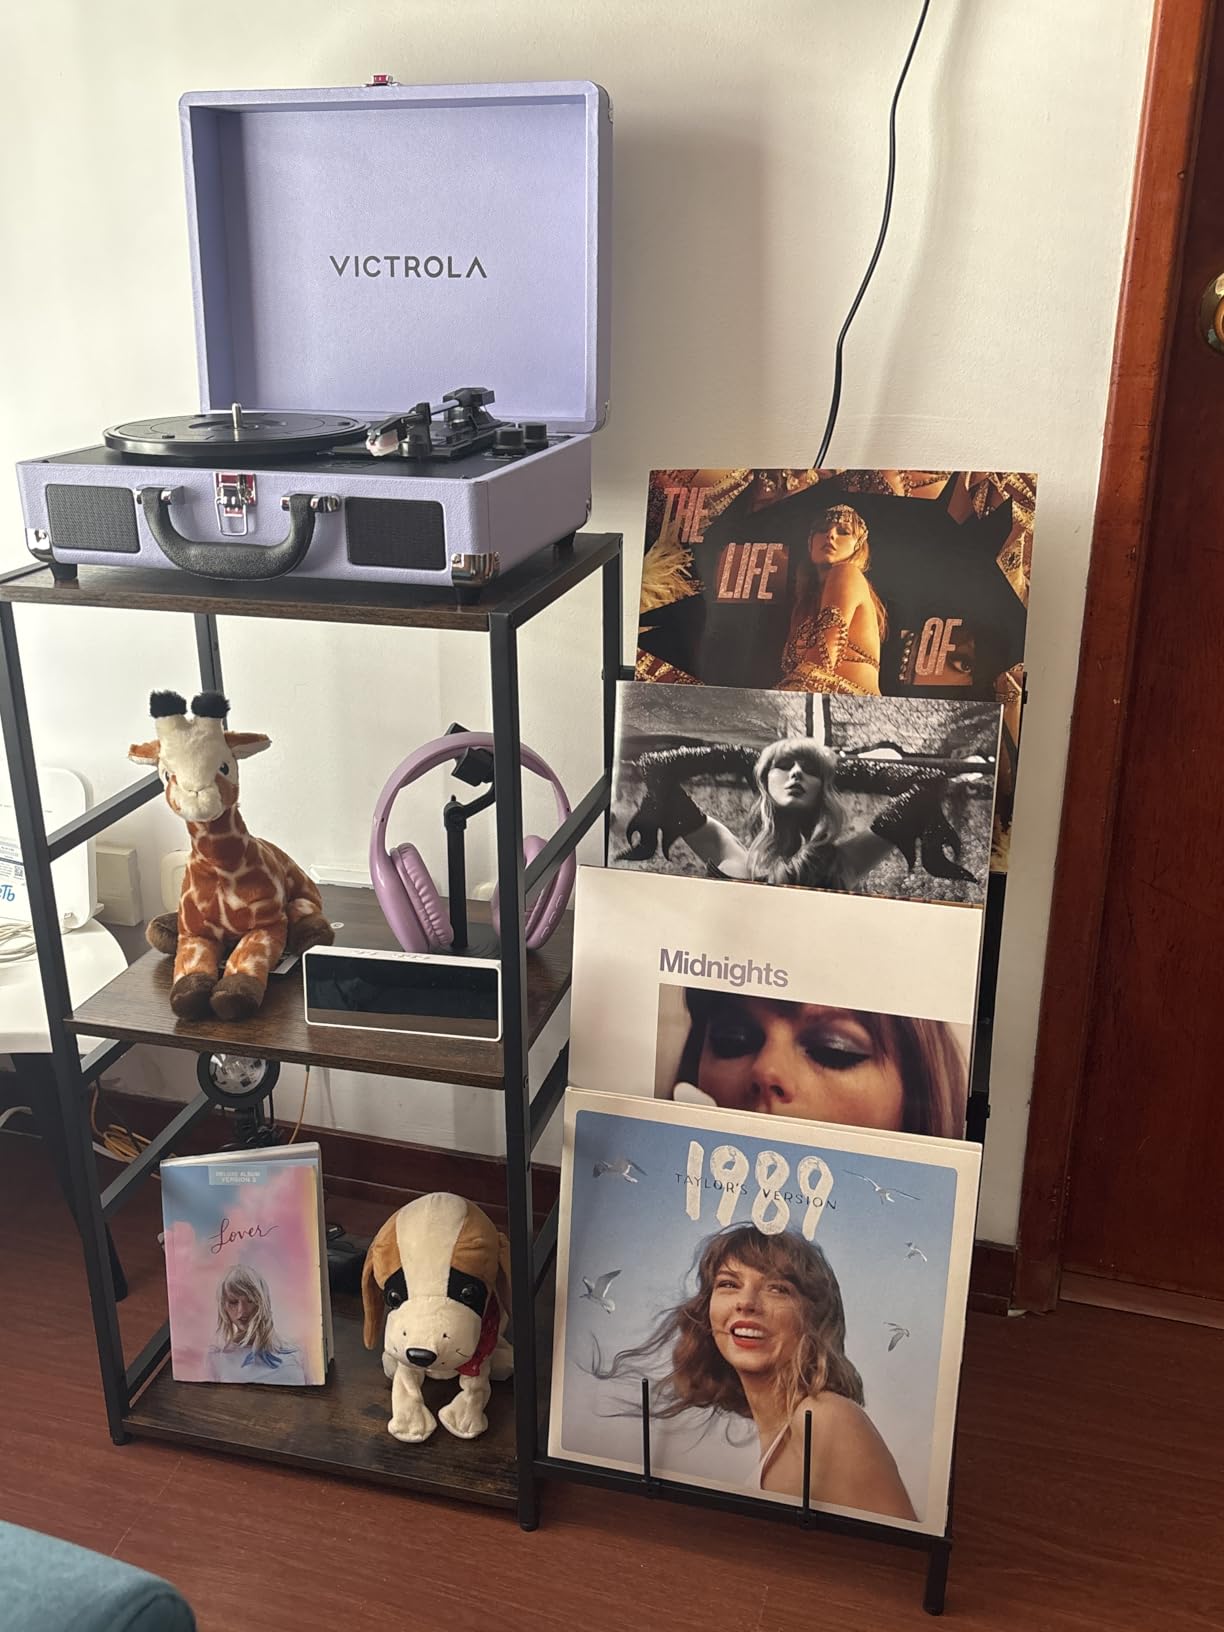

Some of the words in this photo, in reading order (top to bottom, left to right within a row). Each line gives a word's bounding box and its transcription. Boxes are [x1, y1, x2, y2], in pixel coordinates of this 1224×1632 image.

[329, 255, 488, 278] VICTROLA
[658, 487, 714, 543] THE
[718, 542, 784, 599] LIFE
[914, 617, 963, 676] OF
[659, 948, 789, 988] Midnights
[675, 1172, 748, 1195] TAYLOR'S
[762, 1188, 838, 1210] VERSION
[685, 1140, 834, 1242] 1989
[209, 1218, 279, 1254] Lover
